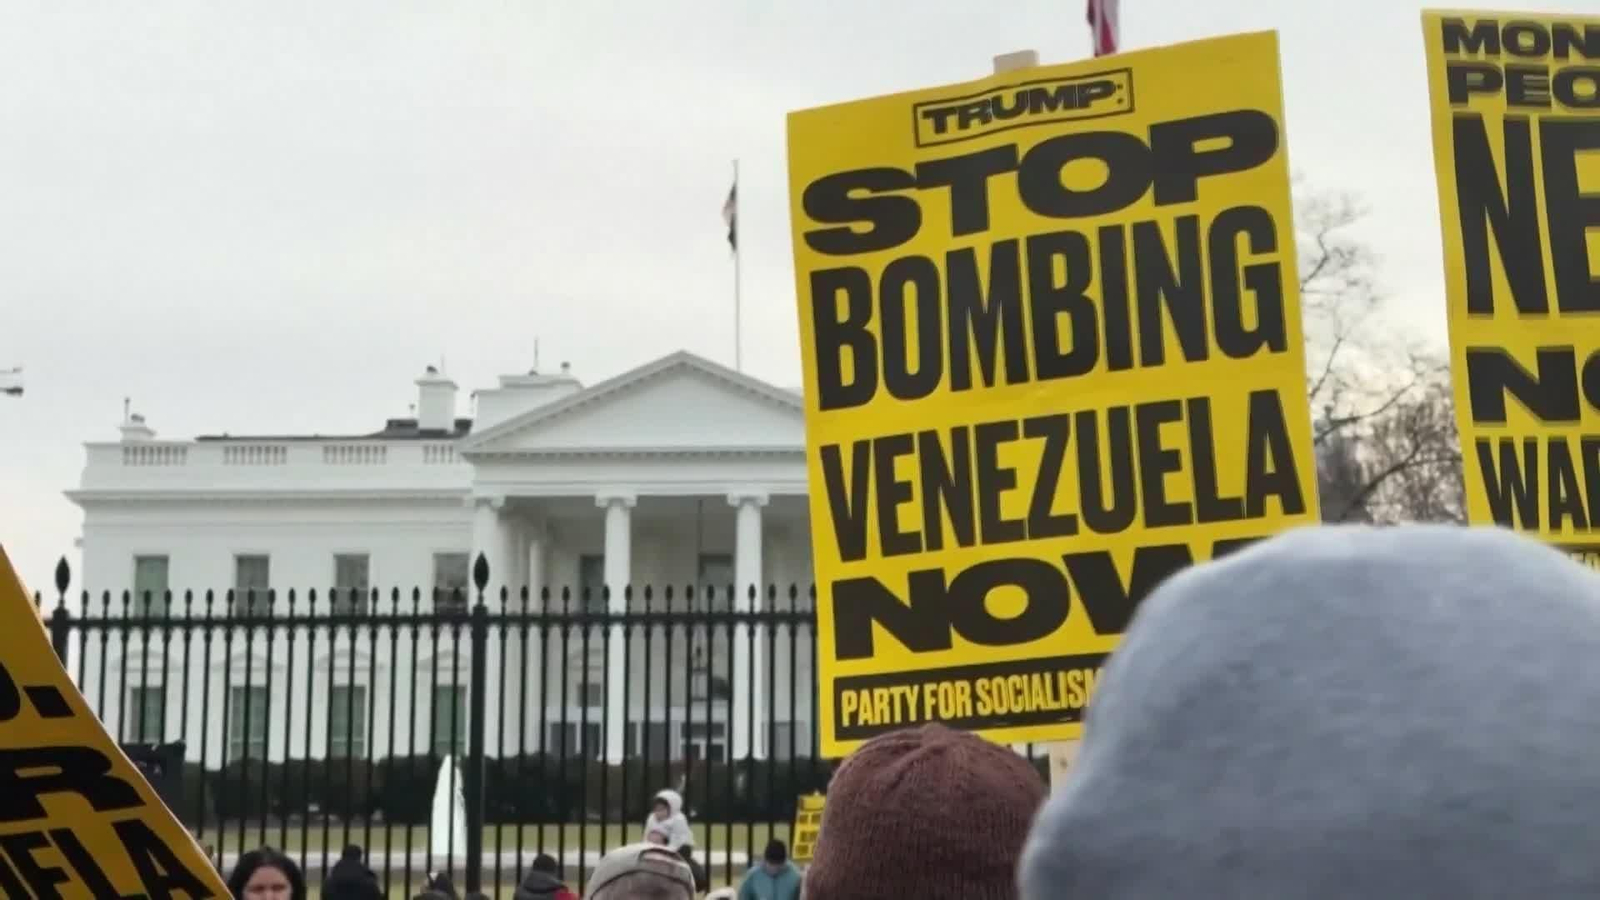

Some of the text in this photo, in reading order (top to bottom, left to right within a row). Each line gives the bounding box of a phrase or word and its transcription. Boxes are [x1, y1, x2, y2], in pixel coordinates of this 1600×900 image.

[923, 80, 1123, 134] TRUMP:
[802, 109, 1279, 255] STOP
[810, 205, 1288, 411] BOMBING
[819, 389, 1306, 563] VENEZUELA
[841, 685, 919, 727] PARTY
[924, 680, 973, 721] FOR
